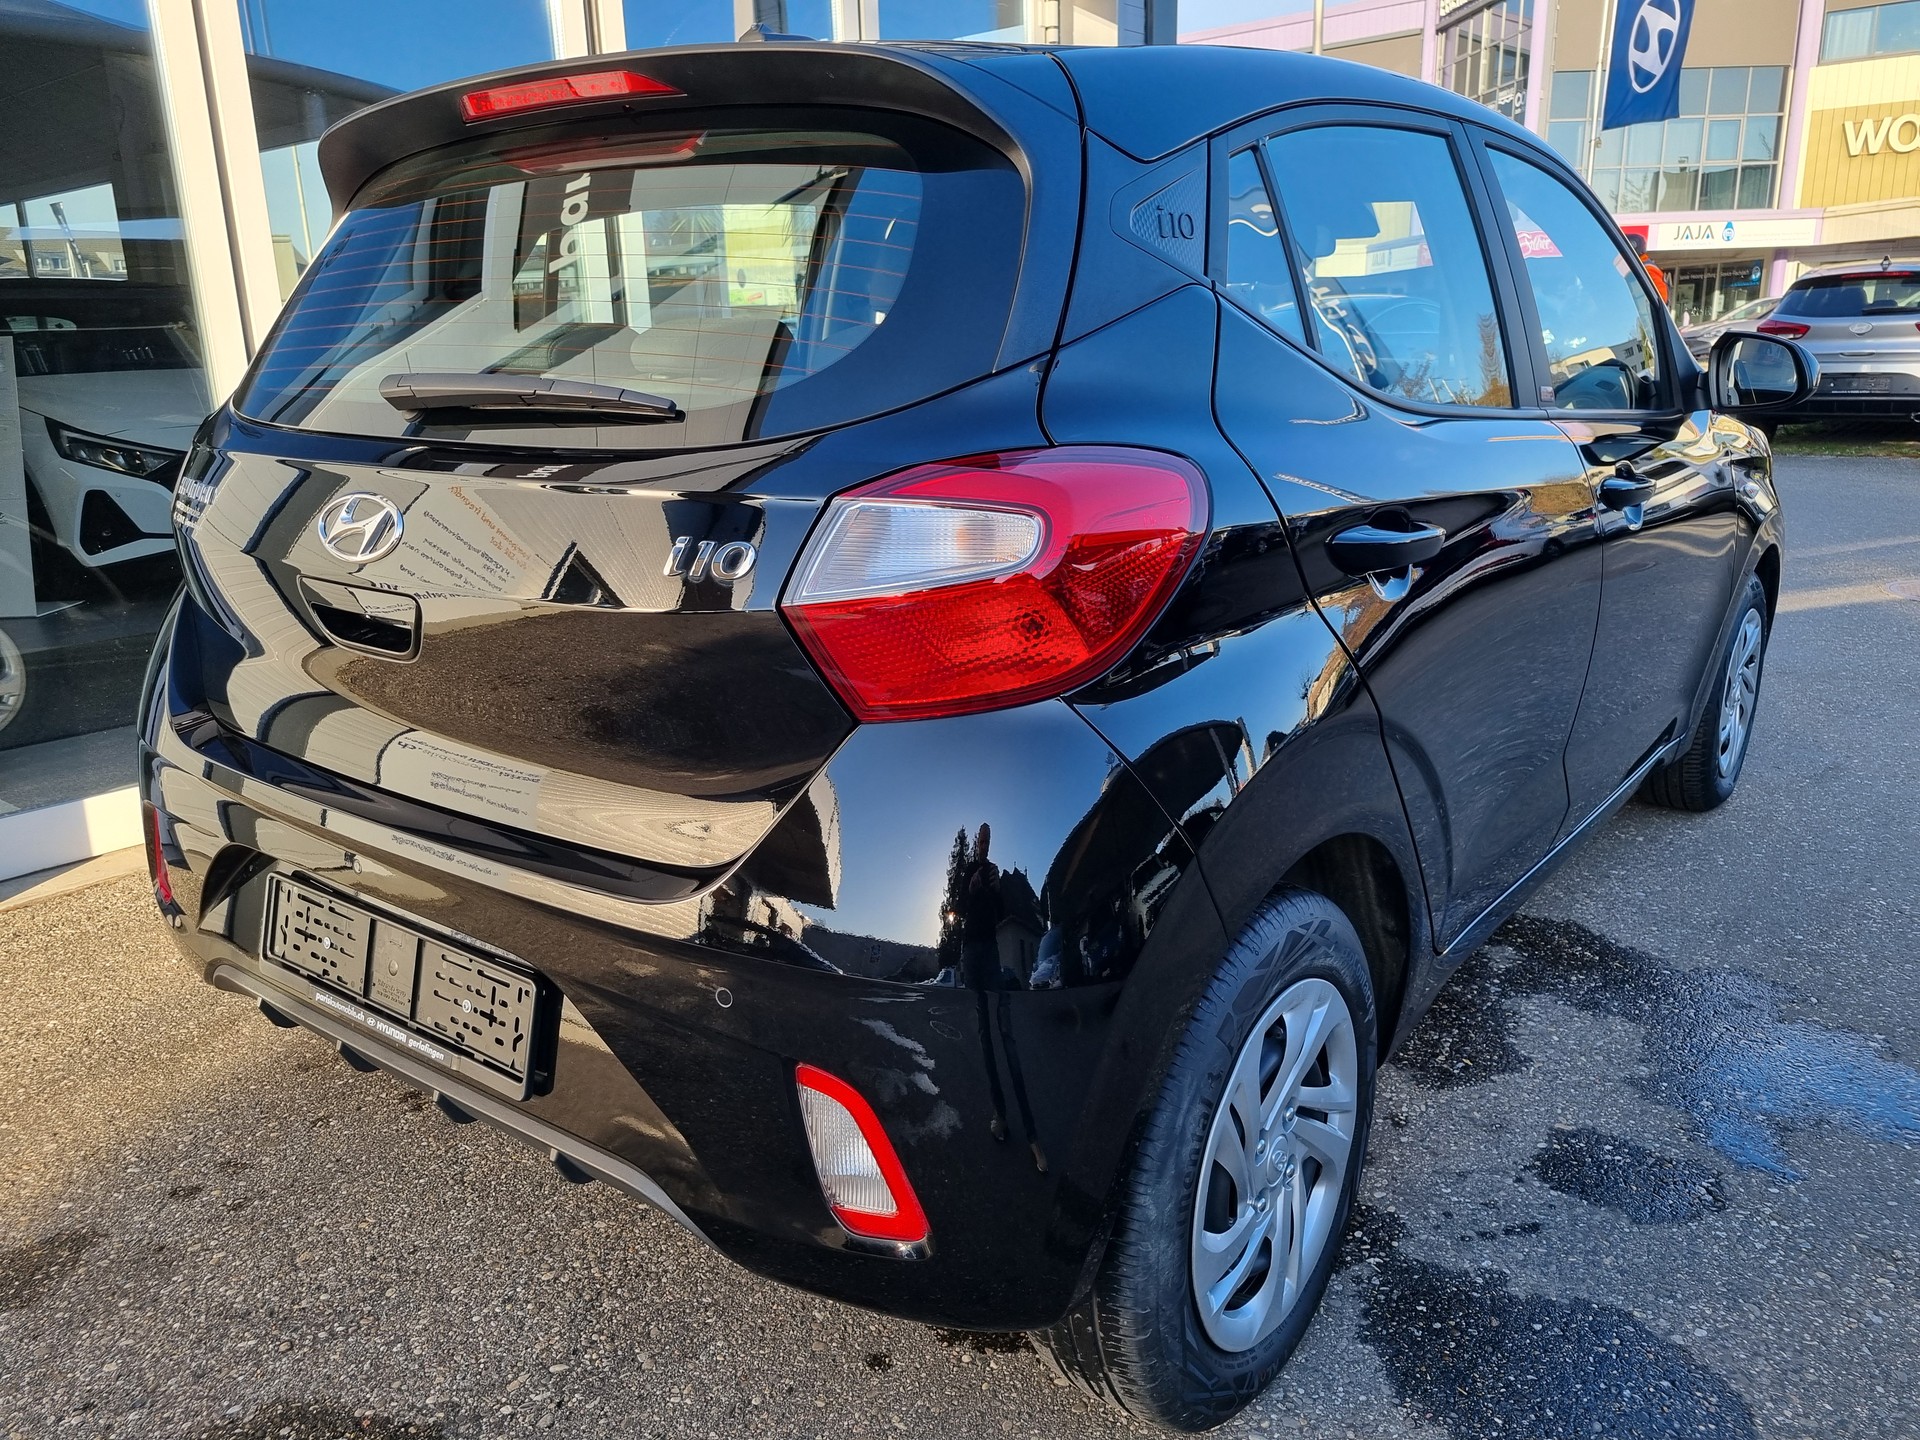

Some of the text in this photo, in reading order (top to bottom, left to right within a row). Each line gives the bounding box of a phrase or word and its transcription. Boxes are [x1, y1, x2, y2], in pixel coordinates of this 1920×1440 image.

[1157, 205, 1195, 240] i10
[1673, 224, 1715, 241] JAJA
[662, 535, 757, 581] i10
[376, 1020, 407, 1043] HYUNDAI
[408, 1038, 445, 1061] gerlafingen
